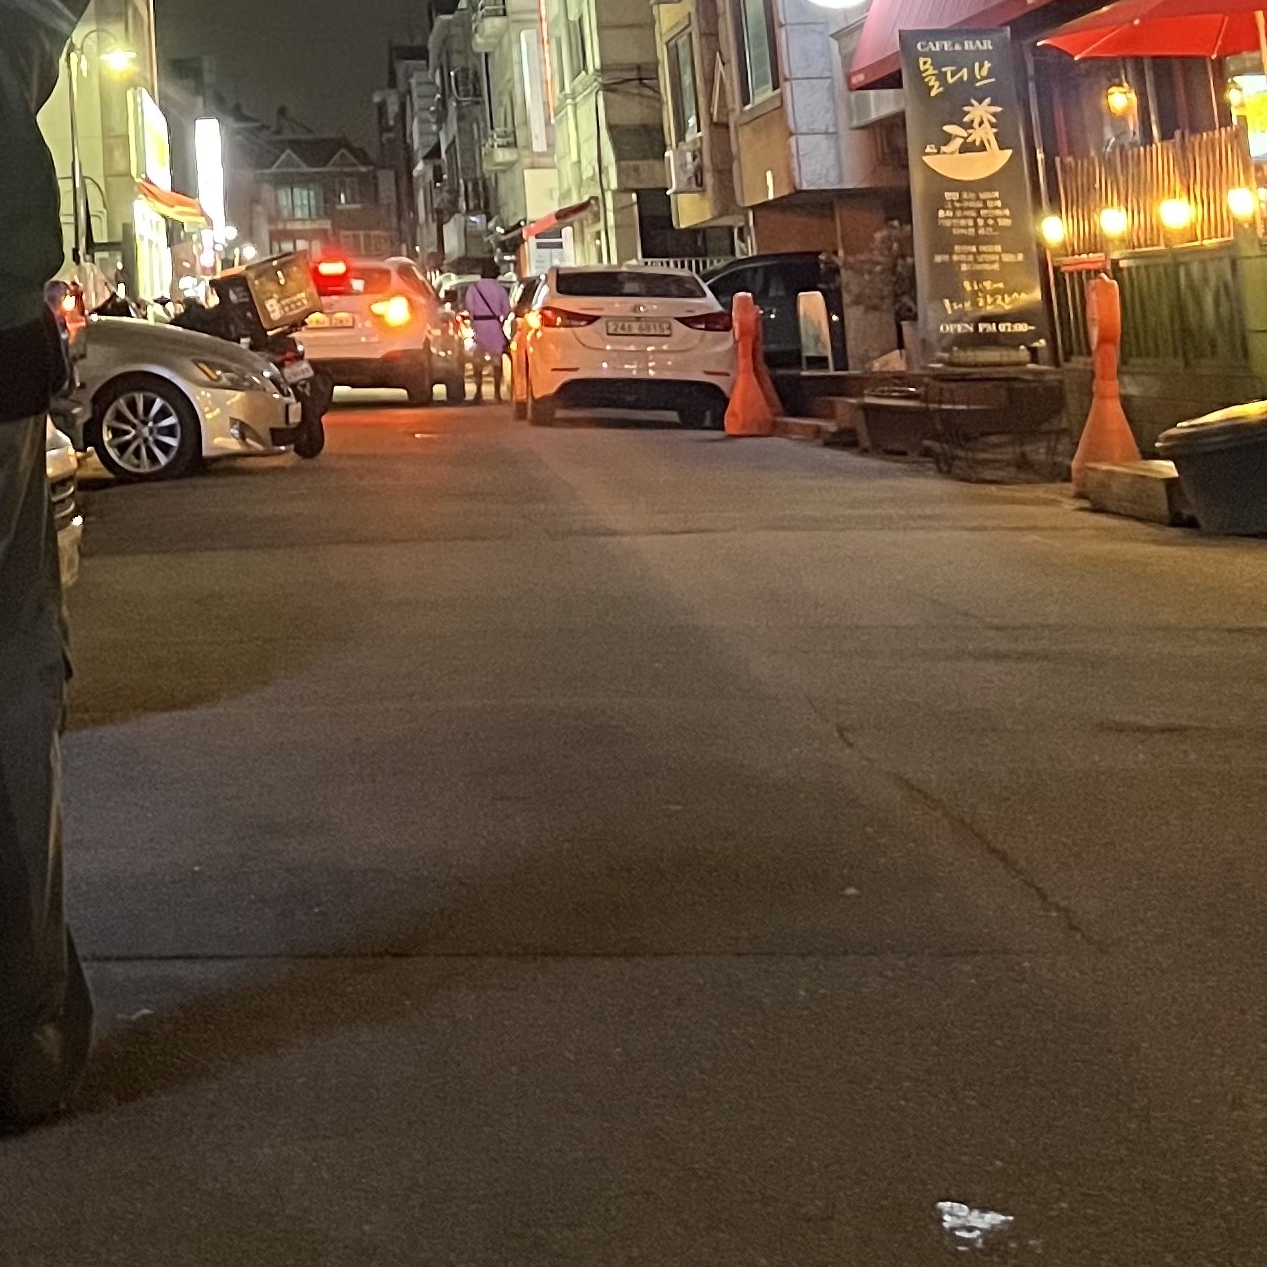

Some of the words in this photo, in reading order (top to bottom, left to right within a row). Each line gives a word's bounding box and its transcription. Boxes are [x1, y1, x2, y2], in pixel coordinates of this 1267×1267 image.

[916, 40, 953, 52] CAFE
[964, 39, 993, 51] BAR
[939, 323, 974, 334] OPEN
